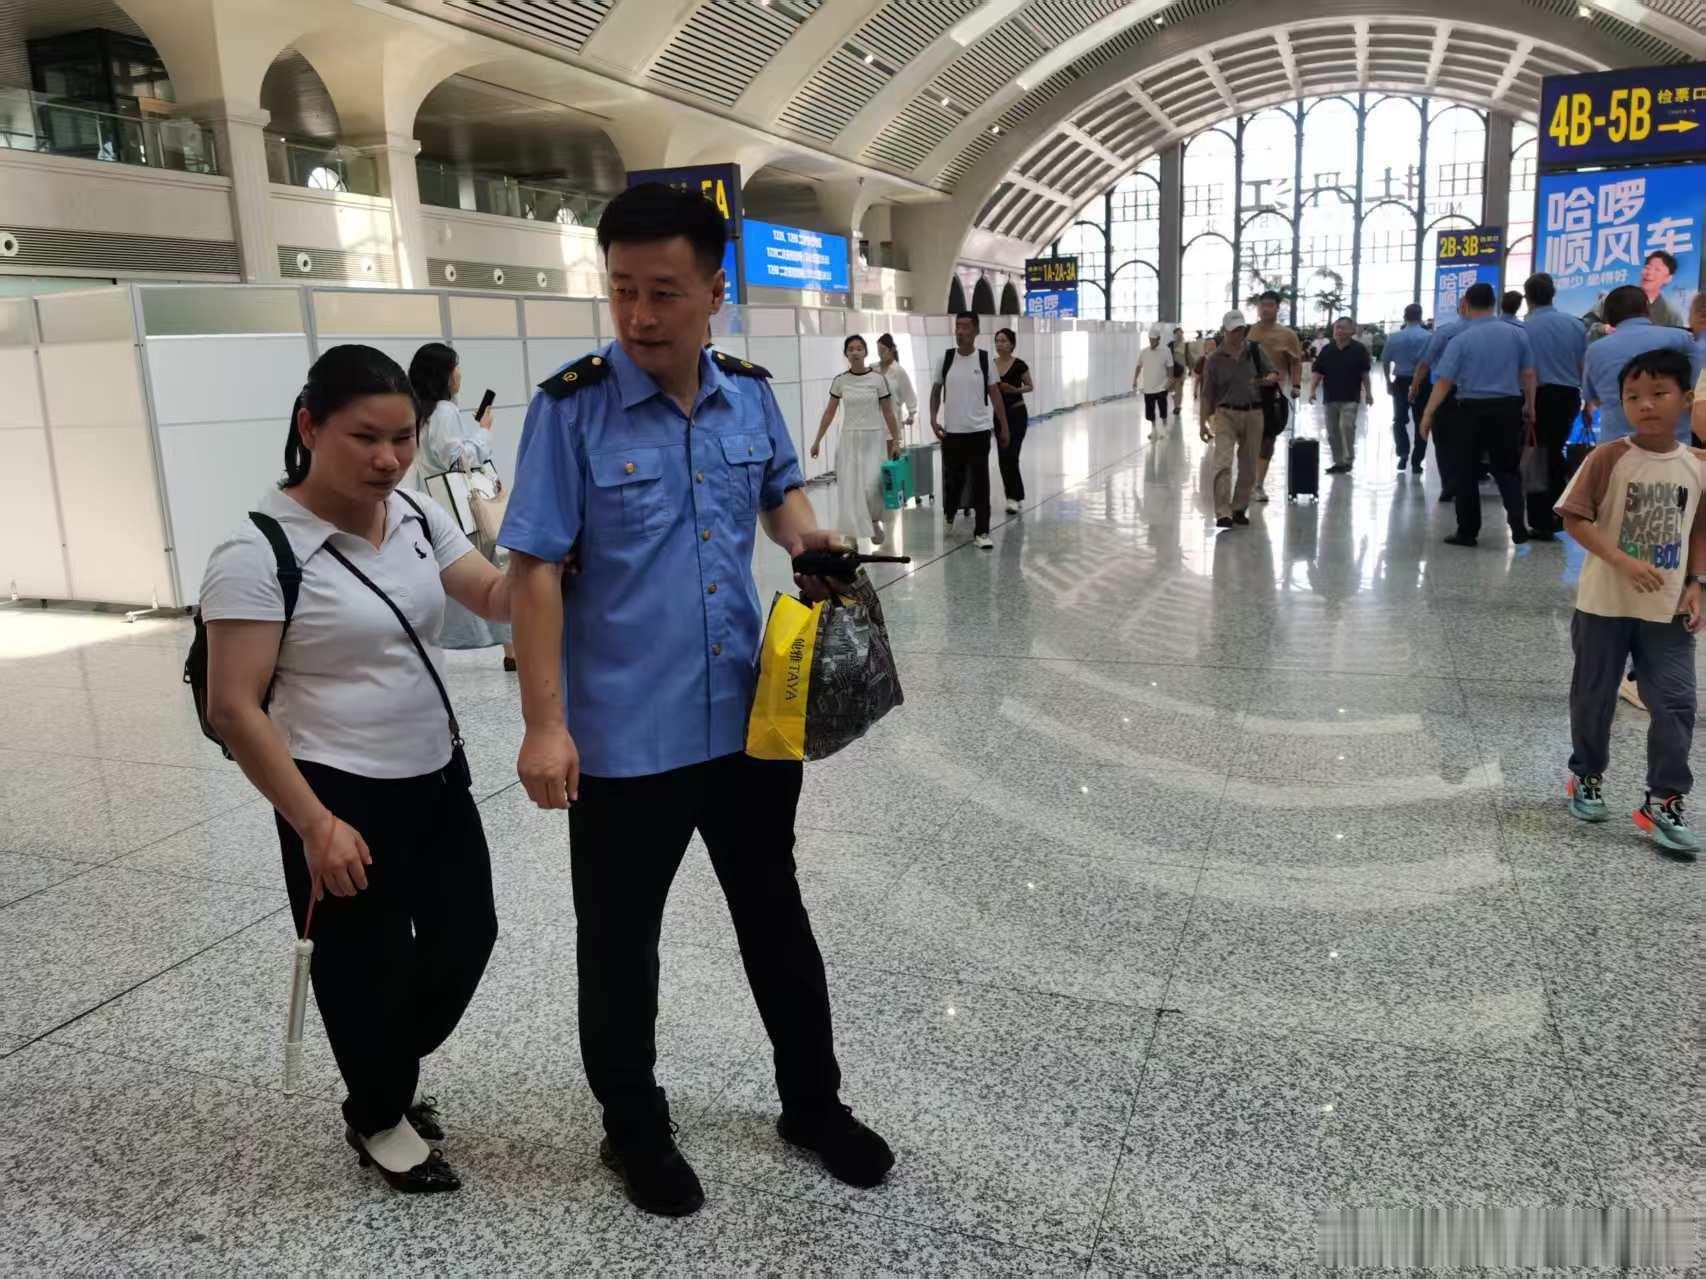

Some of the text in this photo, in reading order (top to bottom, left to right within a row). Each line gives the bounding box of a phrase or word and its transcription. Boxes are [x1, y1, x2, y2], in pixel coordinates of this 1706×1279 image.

[1550, 87, 1652, 147] 4B-5B
[1547, 177, 1646, 232] 哈啰
[1439, 235, 1479, 258] 2B-3B
[1544, 217, 1694, 275] 顺风车
